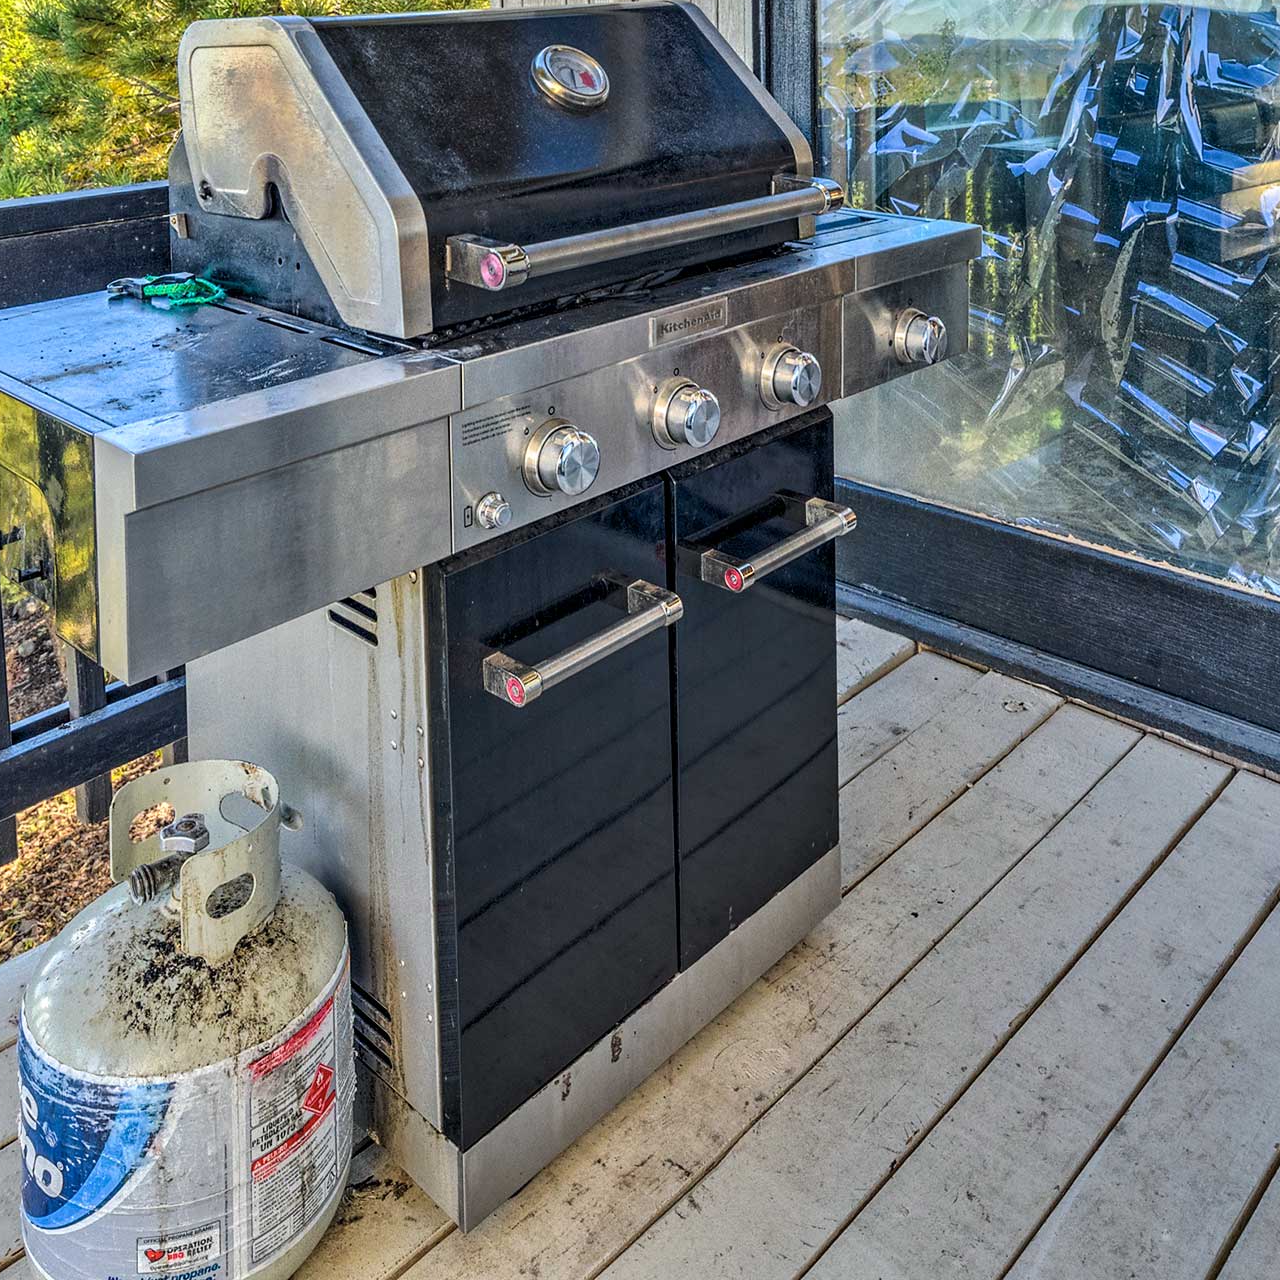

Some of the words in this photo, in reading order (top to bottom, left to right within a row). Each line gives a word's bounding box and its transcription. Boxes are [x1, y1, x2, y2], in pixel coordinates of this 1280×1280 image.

[660, 308, 723, 336] KitchenAid
[167, 1236, 213, 1254] OPERATION
[187, 1243, 213, 1257] RELIEF
